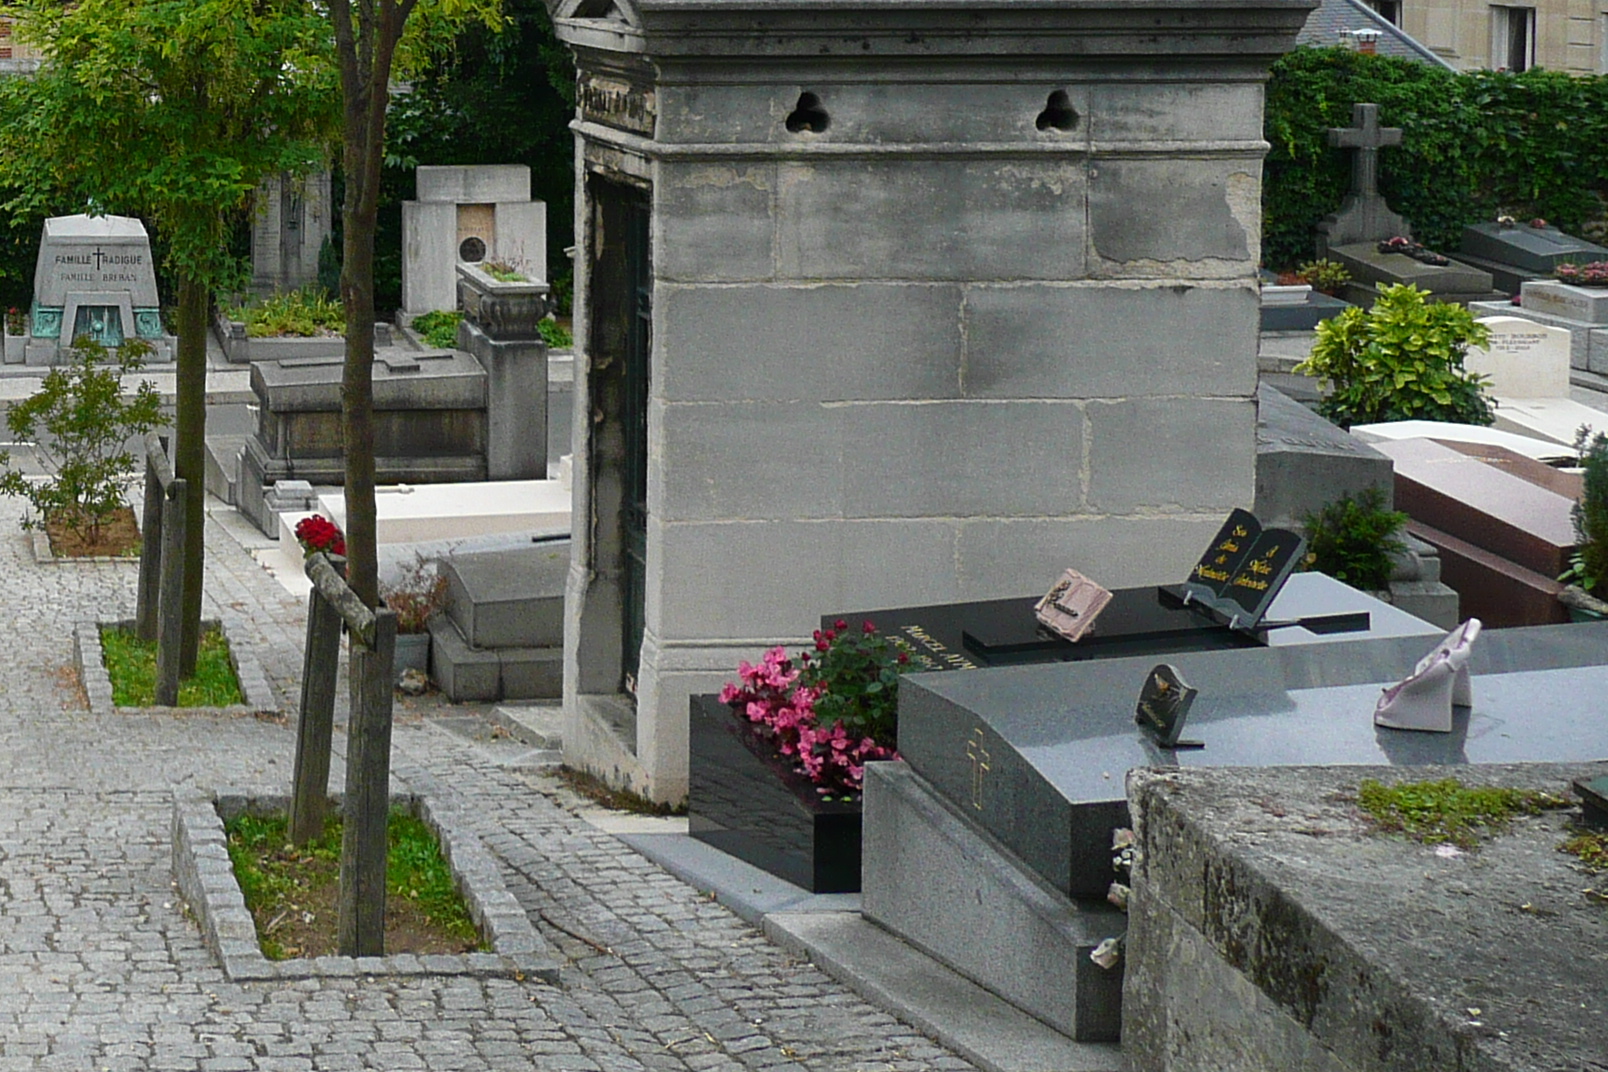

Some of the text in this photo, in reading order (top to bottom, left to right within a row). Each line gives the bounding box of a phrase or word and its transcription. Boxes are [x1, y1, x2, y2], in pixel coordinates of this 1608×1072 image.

[55, 255, 142, 265] FAMILLE RADIGUE
[60, 273, 94, 282] FAMILLE
[900, 625, 978, 670] MARCEL AYM
